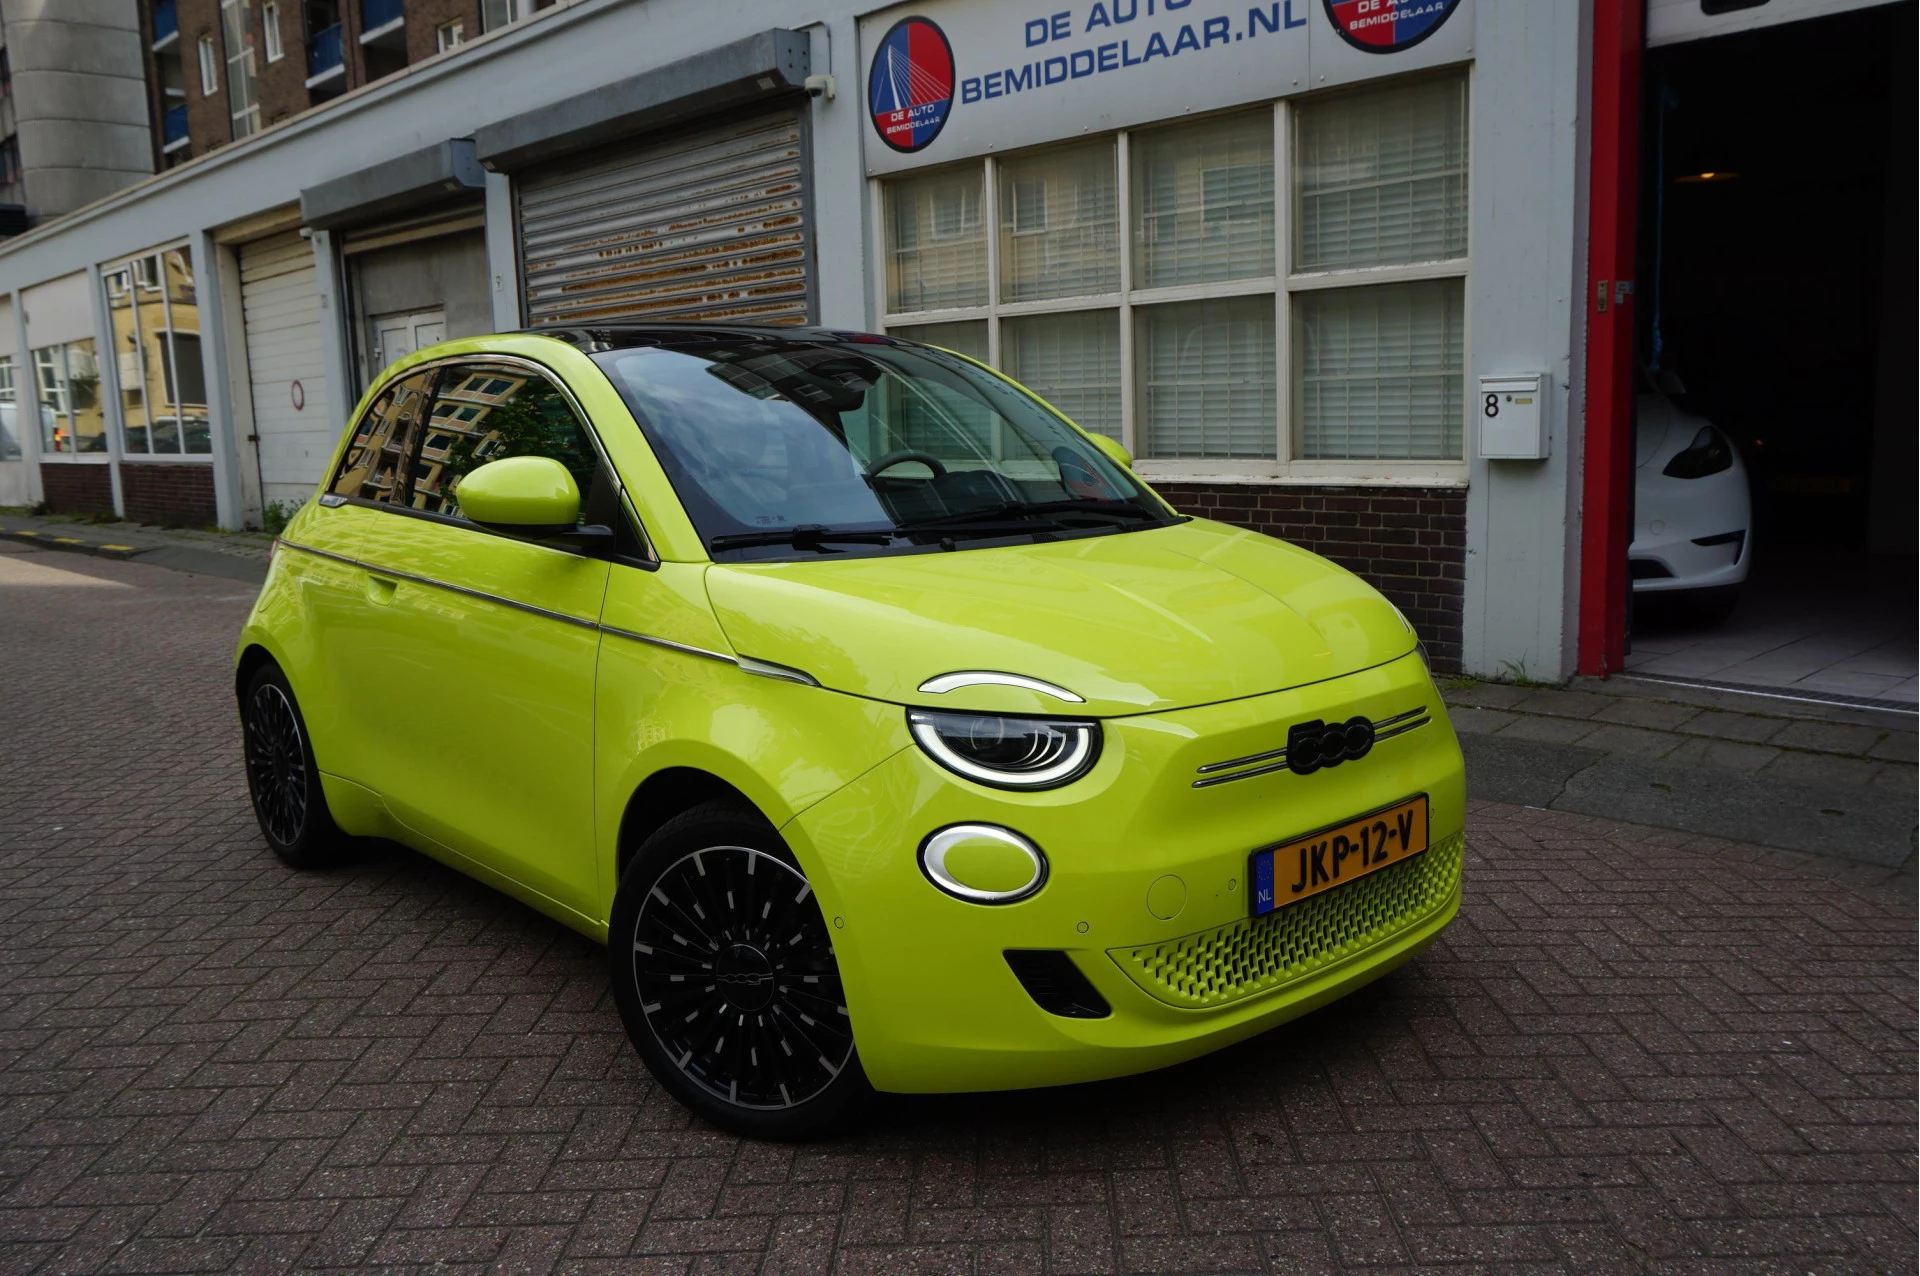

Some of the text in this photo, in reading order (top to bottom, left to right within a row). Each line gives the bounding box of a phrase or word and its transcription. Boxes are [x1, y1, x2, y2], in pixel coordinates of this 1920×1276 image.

[1349, 2, 1444, 31] BEMIDDELAAR
[1357, 0, 1381, 13] DE
[1025, 10, 1072, 48] DE
[961, 0, 1307, 104] BEMIDDELAAR.NL
[886, 116, 941, 135] BEMIDDELAAR
[890, 104, 935, 122] DE AUTO
[1484, 393, 1499, 418] 8
[1286, 716, 1376, 775] 500
[1291, 809, 1414, 893] JKP-12-V
[1257, 889, 1272, 904] NL
